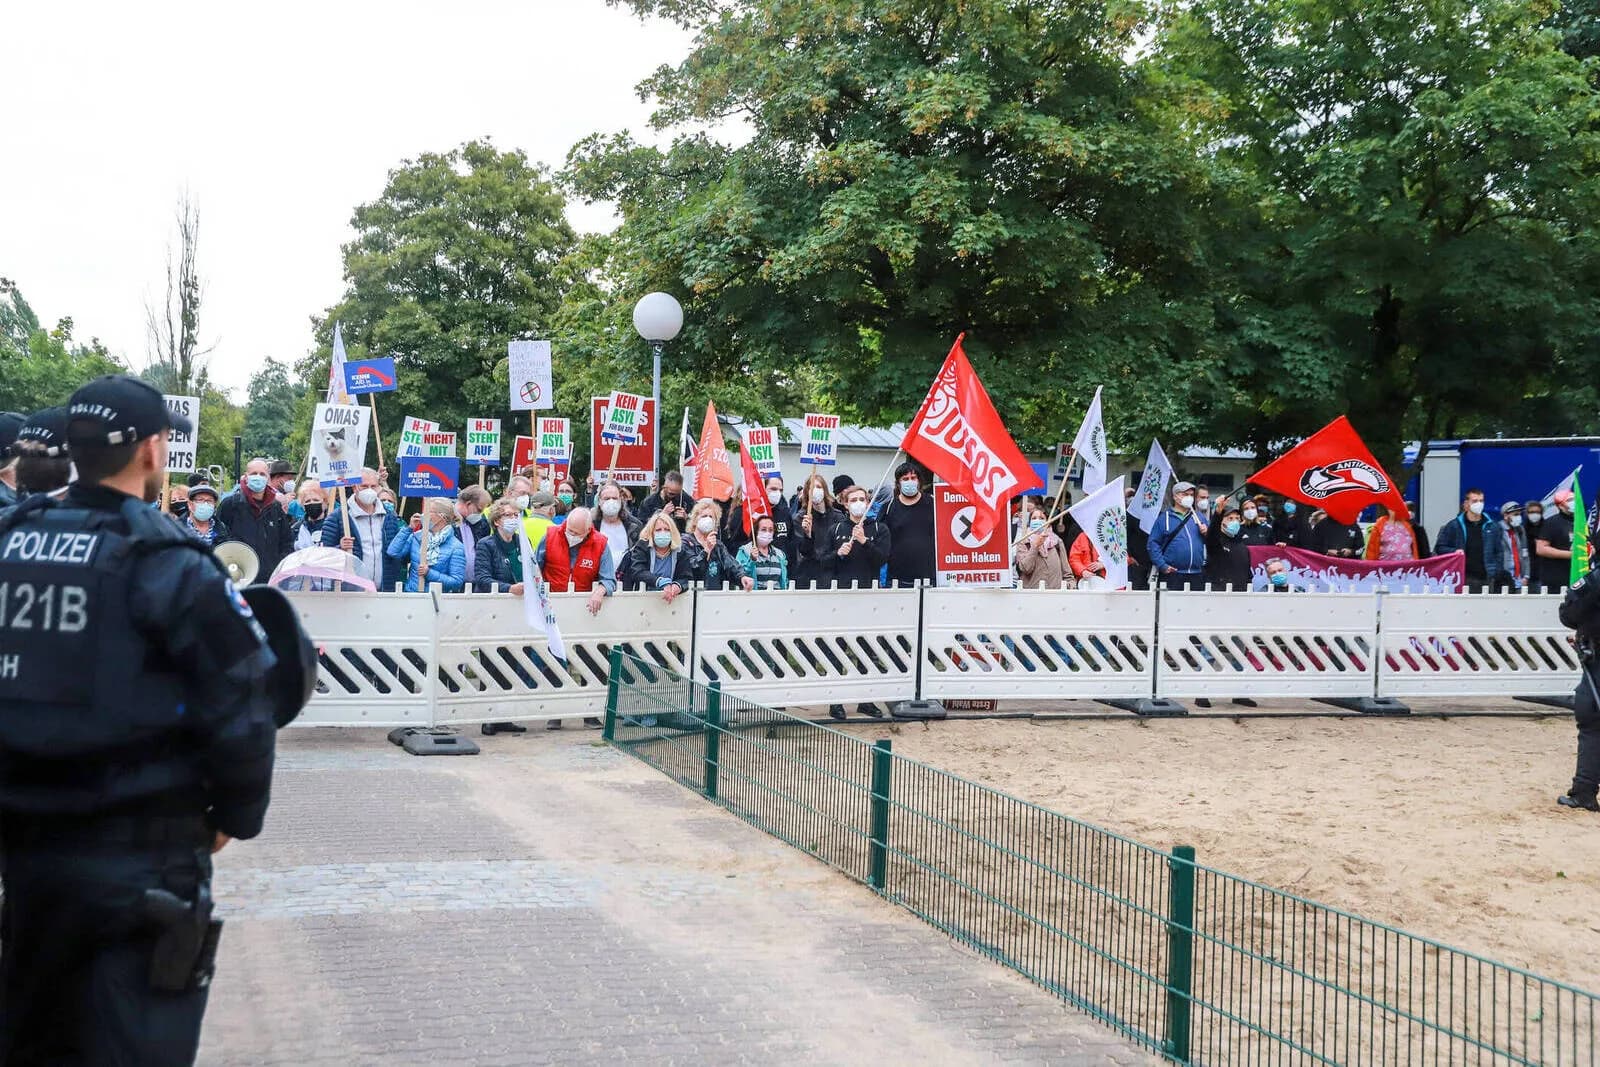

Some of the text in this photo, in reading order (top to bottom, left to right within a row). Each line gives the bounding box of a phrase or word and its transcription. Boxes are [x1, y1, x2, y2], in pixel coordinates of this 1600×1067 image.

[615, 393, 639, 410] KEIN
[70, 402, 118, 421] POLIZEI
[324, 407, 361, 426] OMAS
[611, 407, 635, 426] ASYL
[475, 420, 493, 432] H-U
[543, 419, 565, 434] KEIN
[806, 415, 839, 429] NICHT
[19, 427, 54, 440] POLIZEI
[403, 430, 421, 444] STE
[424, 433, 455, 445] NICHT
[468, 432, 499, 444] STEHT
[542, 433, 564, 448] ASYL
[748, 429, 772, 446] KEIN
[811, 428, 831, 441] MIT
[405, 444, 421, 457] AU
[429, 445, 449, 456] MIT
[474, 445, 493, 456] AUF
[750, 445, 774, 461] ASYL
[807, 442, 832, 456] UNS!
[924, 407, 1007, 498] JUSOS
[329, 460, 348, 471] HIER
[3, 531, 98, 564] POLIZEI
[945, 551, 1001, 564] ohne Haken
[946, 572, 1000, 583] Die PARTEI
